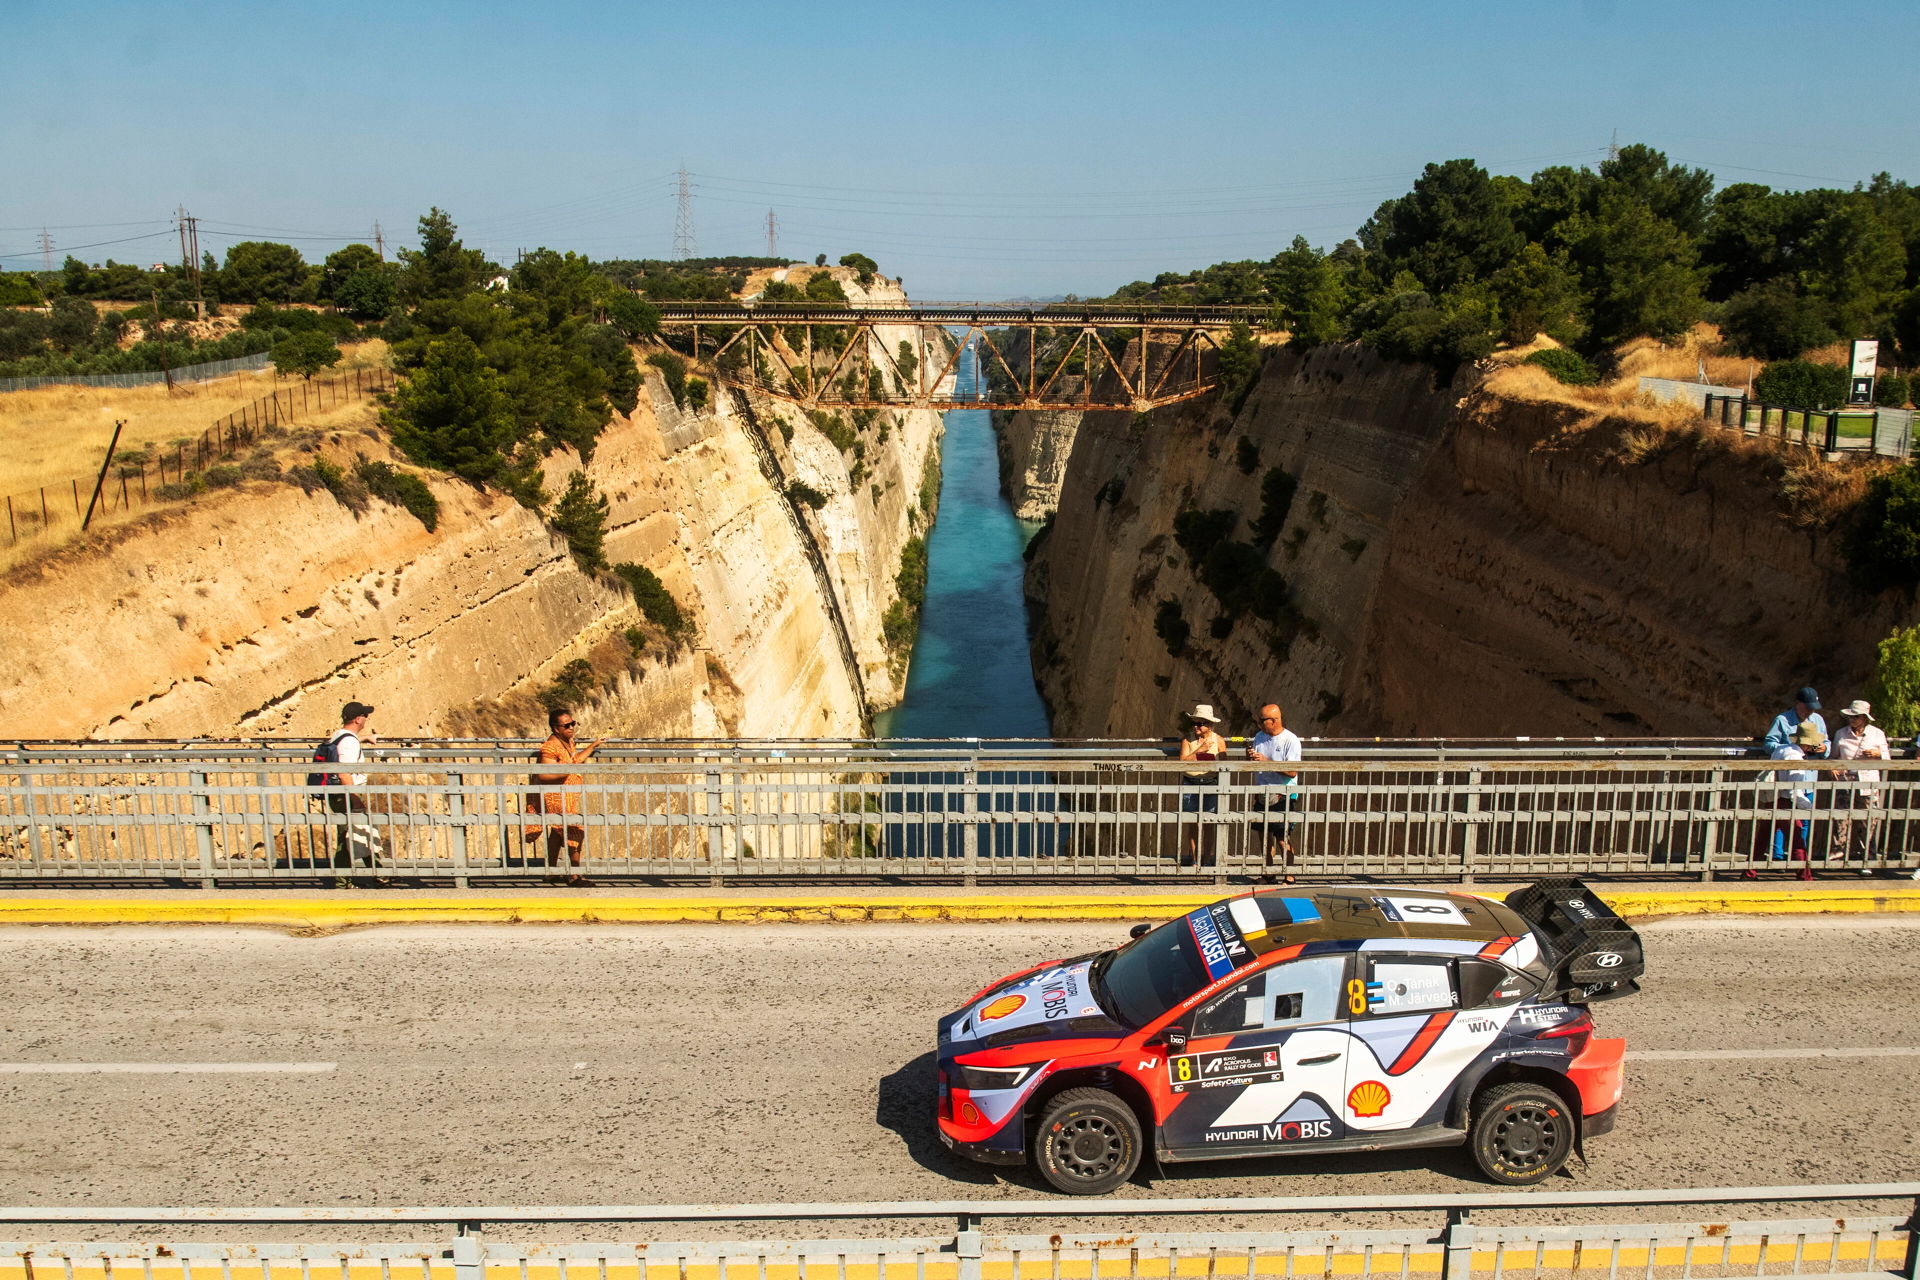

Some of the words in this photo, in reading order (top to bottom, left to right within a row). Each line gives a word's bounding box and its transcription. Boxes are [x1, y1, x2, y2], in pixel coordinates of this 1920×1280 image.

[1403, 905, 1452, 914] 8
[1182, 961, 1261, 1009] motorsport.hyundai.com
[1042, 981, 1068, 1019] MOBIS
[1347, 978, 1367, 1015] 8
[1535, 1006, 1569, 1015] HYUNDAI
[1468, 1019, 1499, 1033] WIA
[1177, 1057, 1192, 1081] 8
[1201, 1077, 1253, 1088] SafetyCulture
[1205, 1130, 1259, 1141] HYUNDAI
[1262, 1121, 1333, 1141] MOBIS
